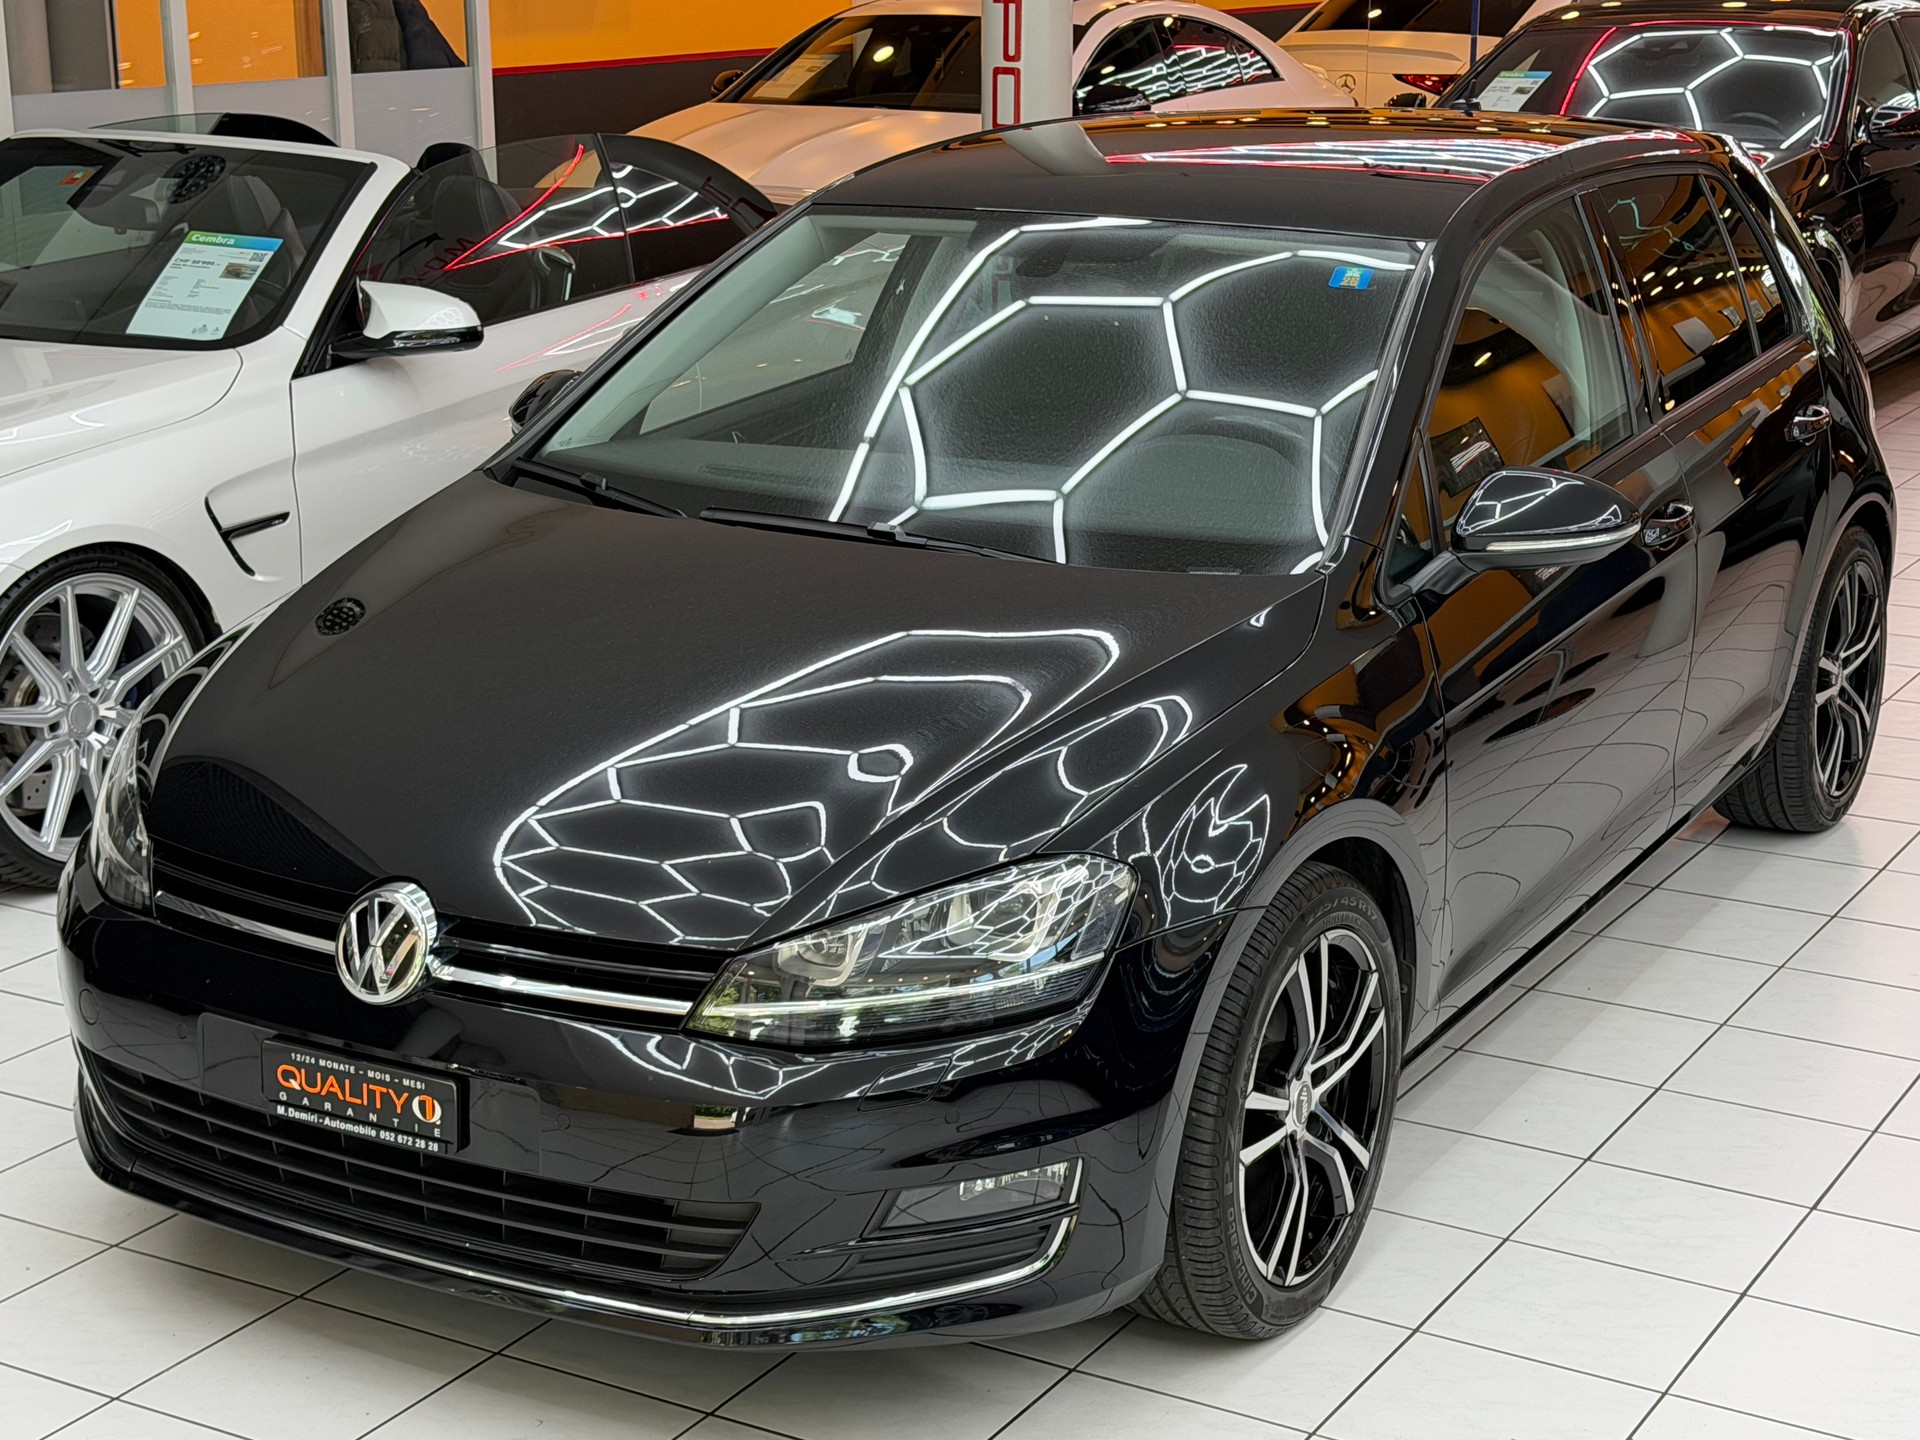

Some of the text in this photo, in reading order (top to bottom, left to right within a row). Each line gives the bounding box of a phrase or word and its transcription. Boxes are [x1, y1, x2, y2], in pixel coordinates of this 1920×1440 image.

[191, 234, 235, 245] Cembra
[290, 1052, 316, 1064] 12/24
[318, 1058, 356, 1074] MONATE
[367, 1070, 391, 1082] MOIS
[402, 1078, 425, 1090] MESI
[380, 1130, 396, 1143] 052
[397, 1133, 413, 1146] 672
[415, 1137, 426, 1149] 28
[428, 1141, 439, 1152] 28
